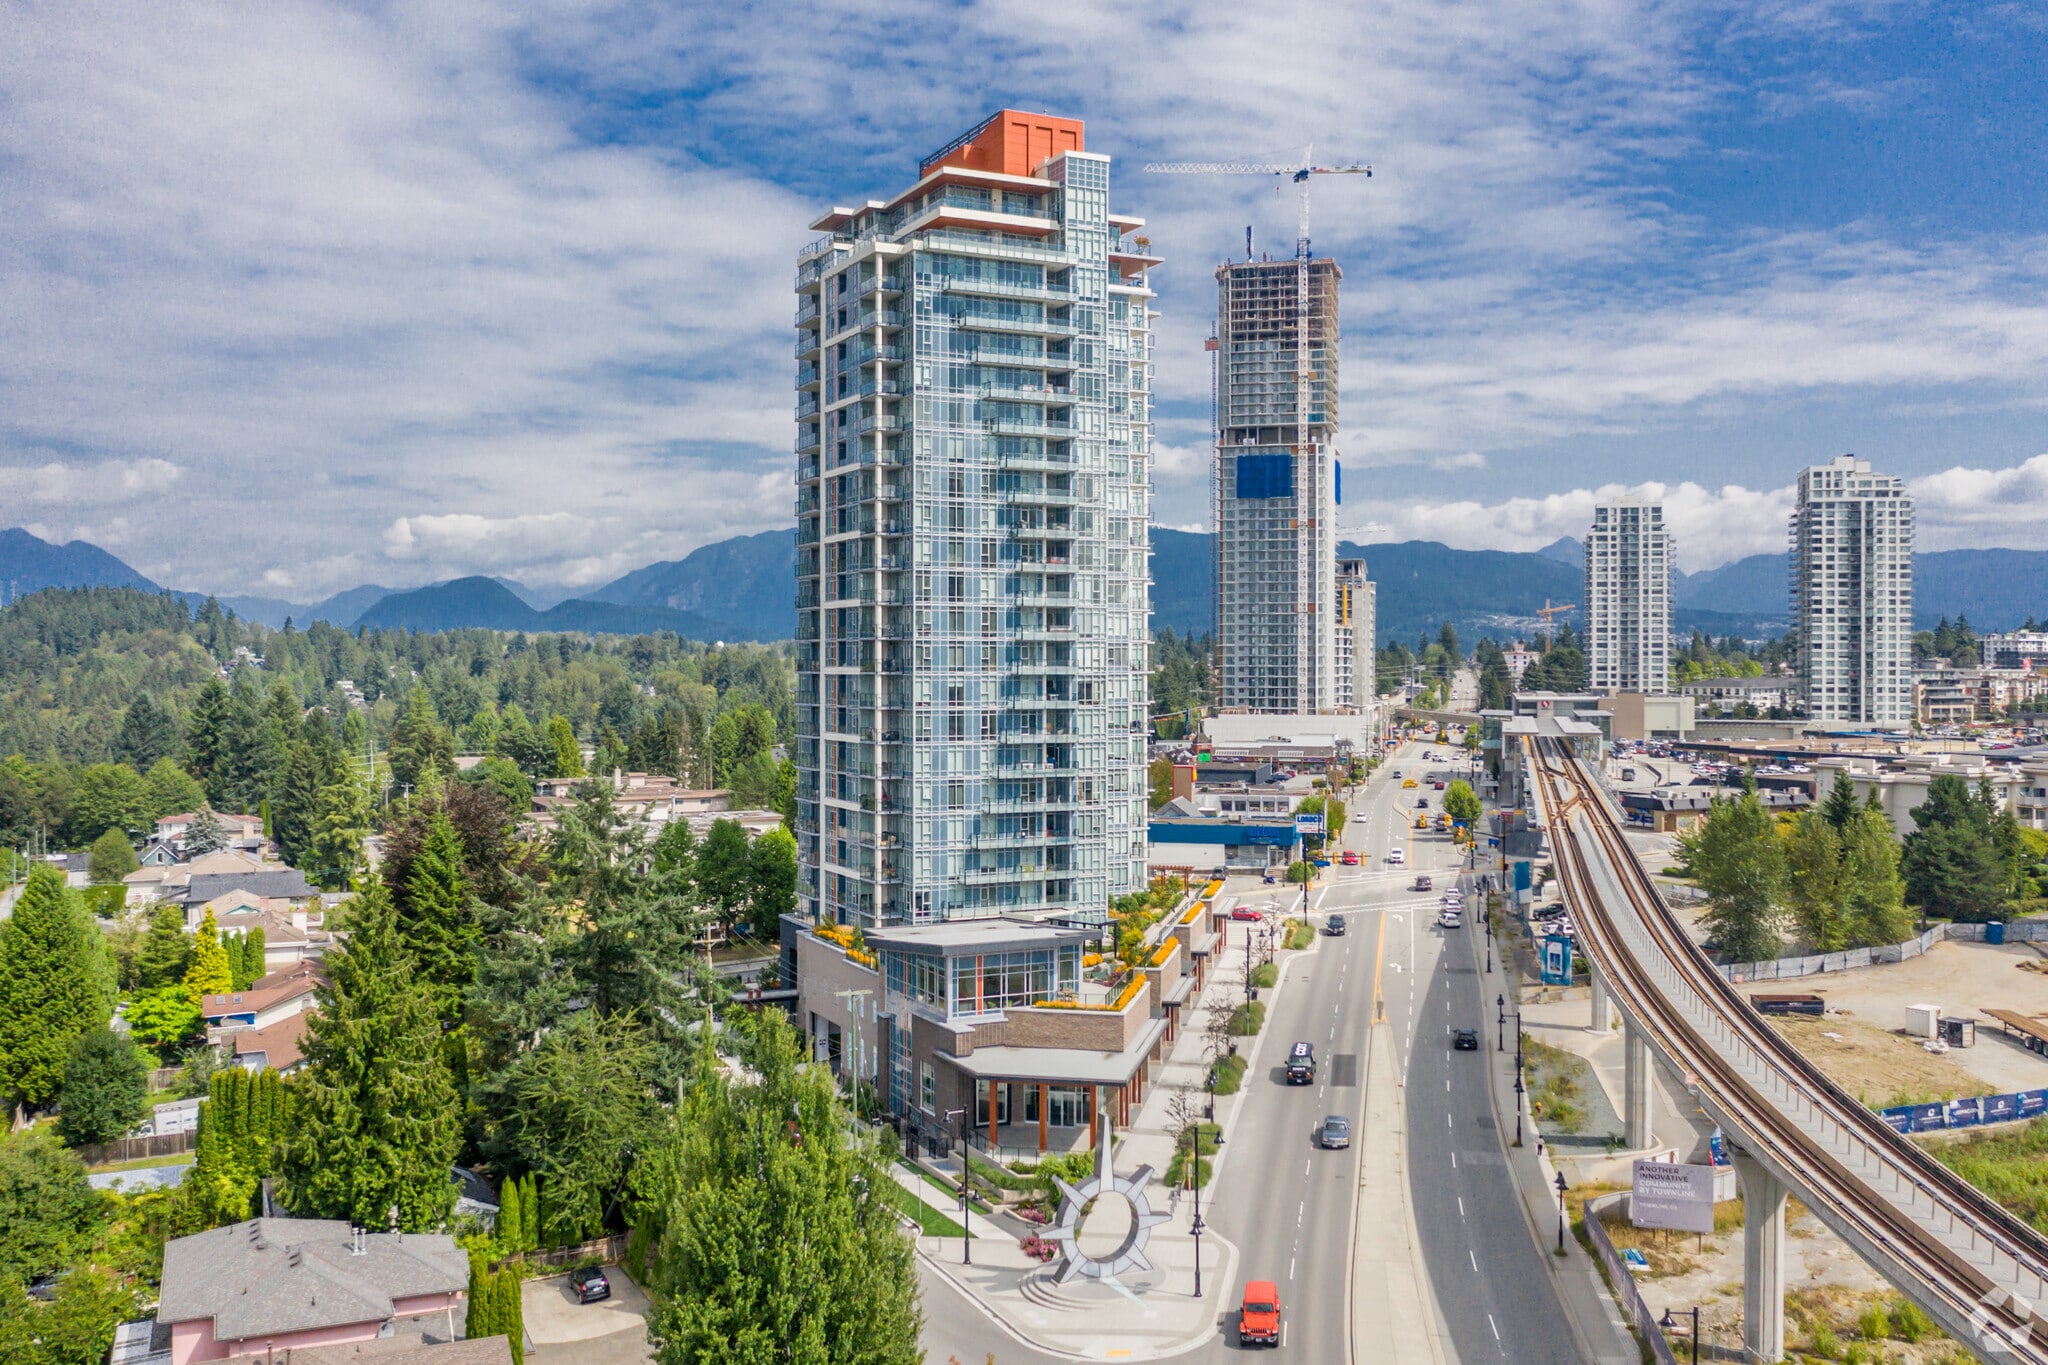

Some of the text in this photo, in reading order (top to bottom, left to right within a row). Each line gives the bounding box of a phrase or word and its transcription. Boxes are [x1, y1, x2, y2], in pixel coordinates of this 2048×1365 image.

[1640, 1165, 1679, 1174] ANOTHER
[1640, 1173, 1689, 1182] INNOVATIVE
[1639, 1180, 1692, 1190] COMMUNITY
[1639, 1187, 1651, 1195] BY
